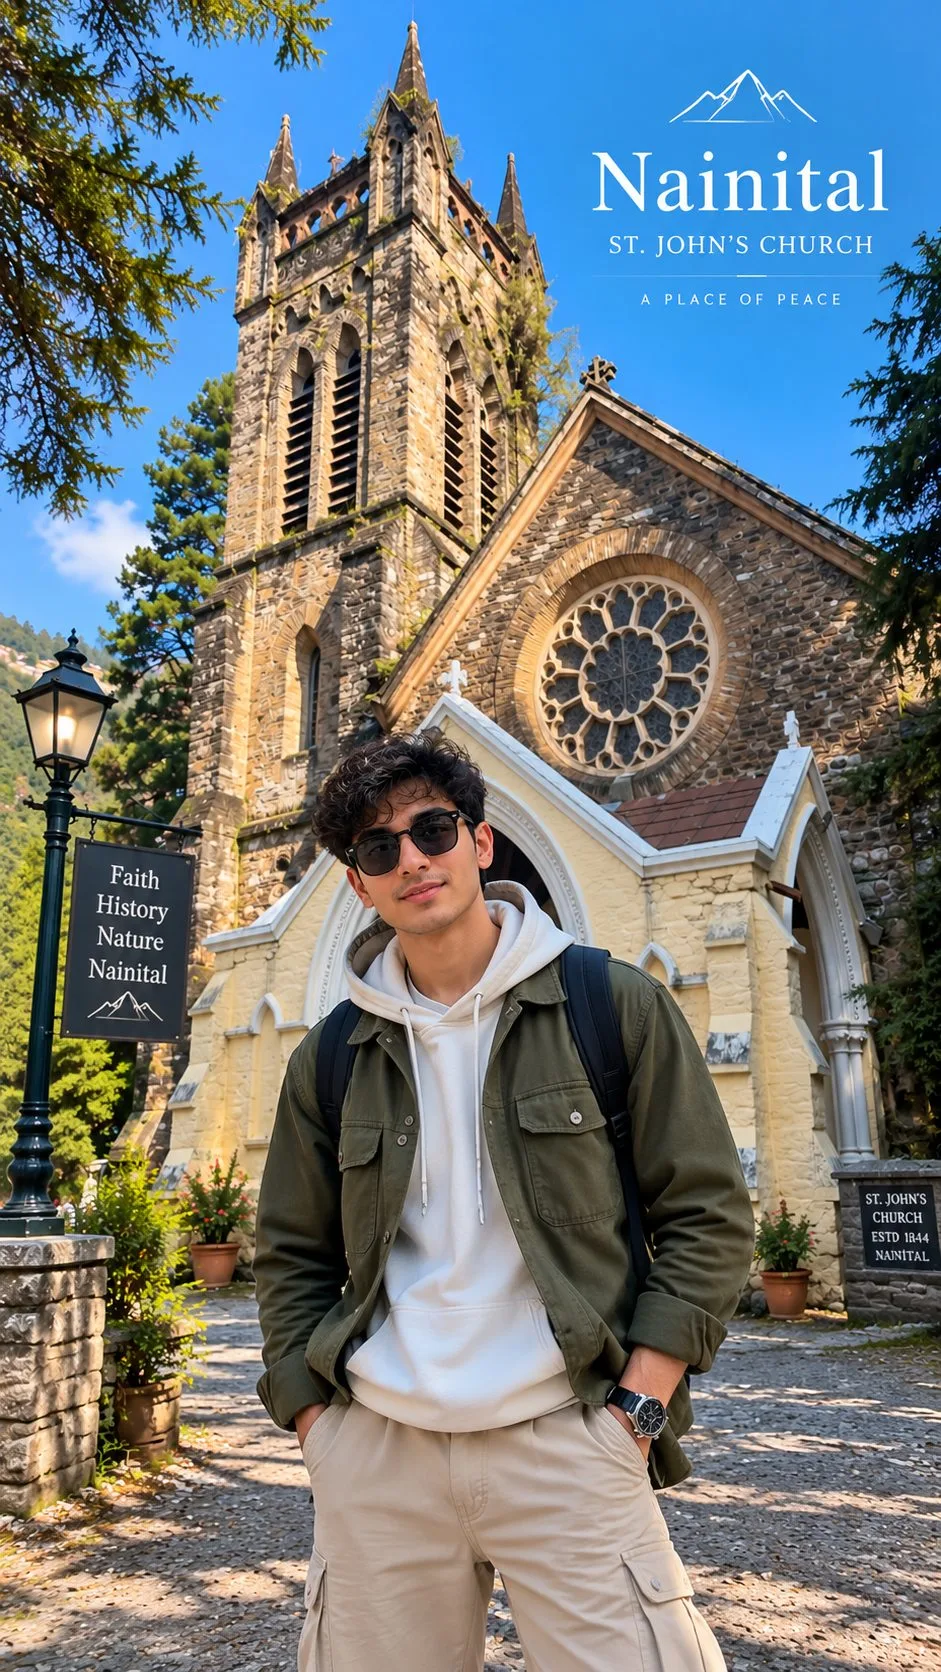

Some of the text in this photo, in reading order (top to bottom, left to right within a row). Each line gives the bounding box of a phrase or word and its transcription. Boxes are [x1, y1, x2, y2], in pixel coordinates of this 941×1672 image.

[110, 864, 160, 890] Faith
[96, 893, 169, 925] History
[96, 925, 164, 951] Nature
[88, 958, 167, 985] Nainital
[865, 1193, 882, 1205] ST.
[872, 1211, 923, 1224] CHURCH
[871, 1231, 900, 1243] ESTD
